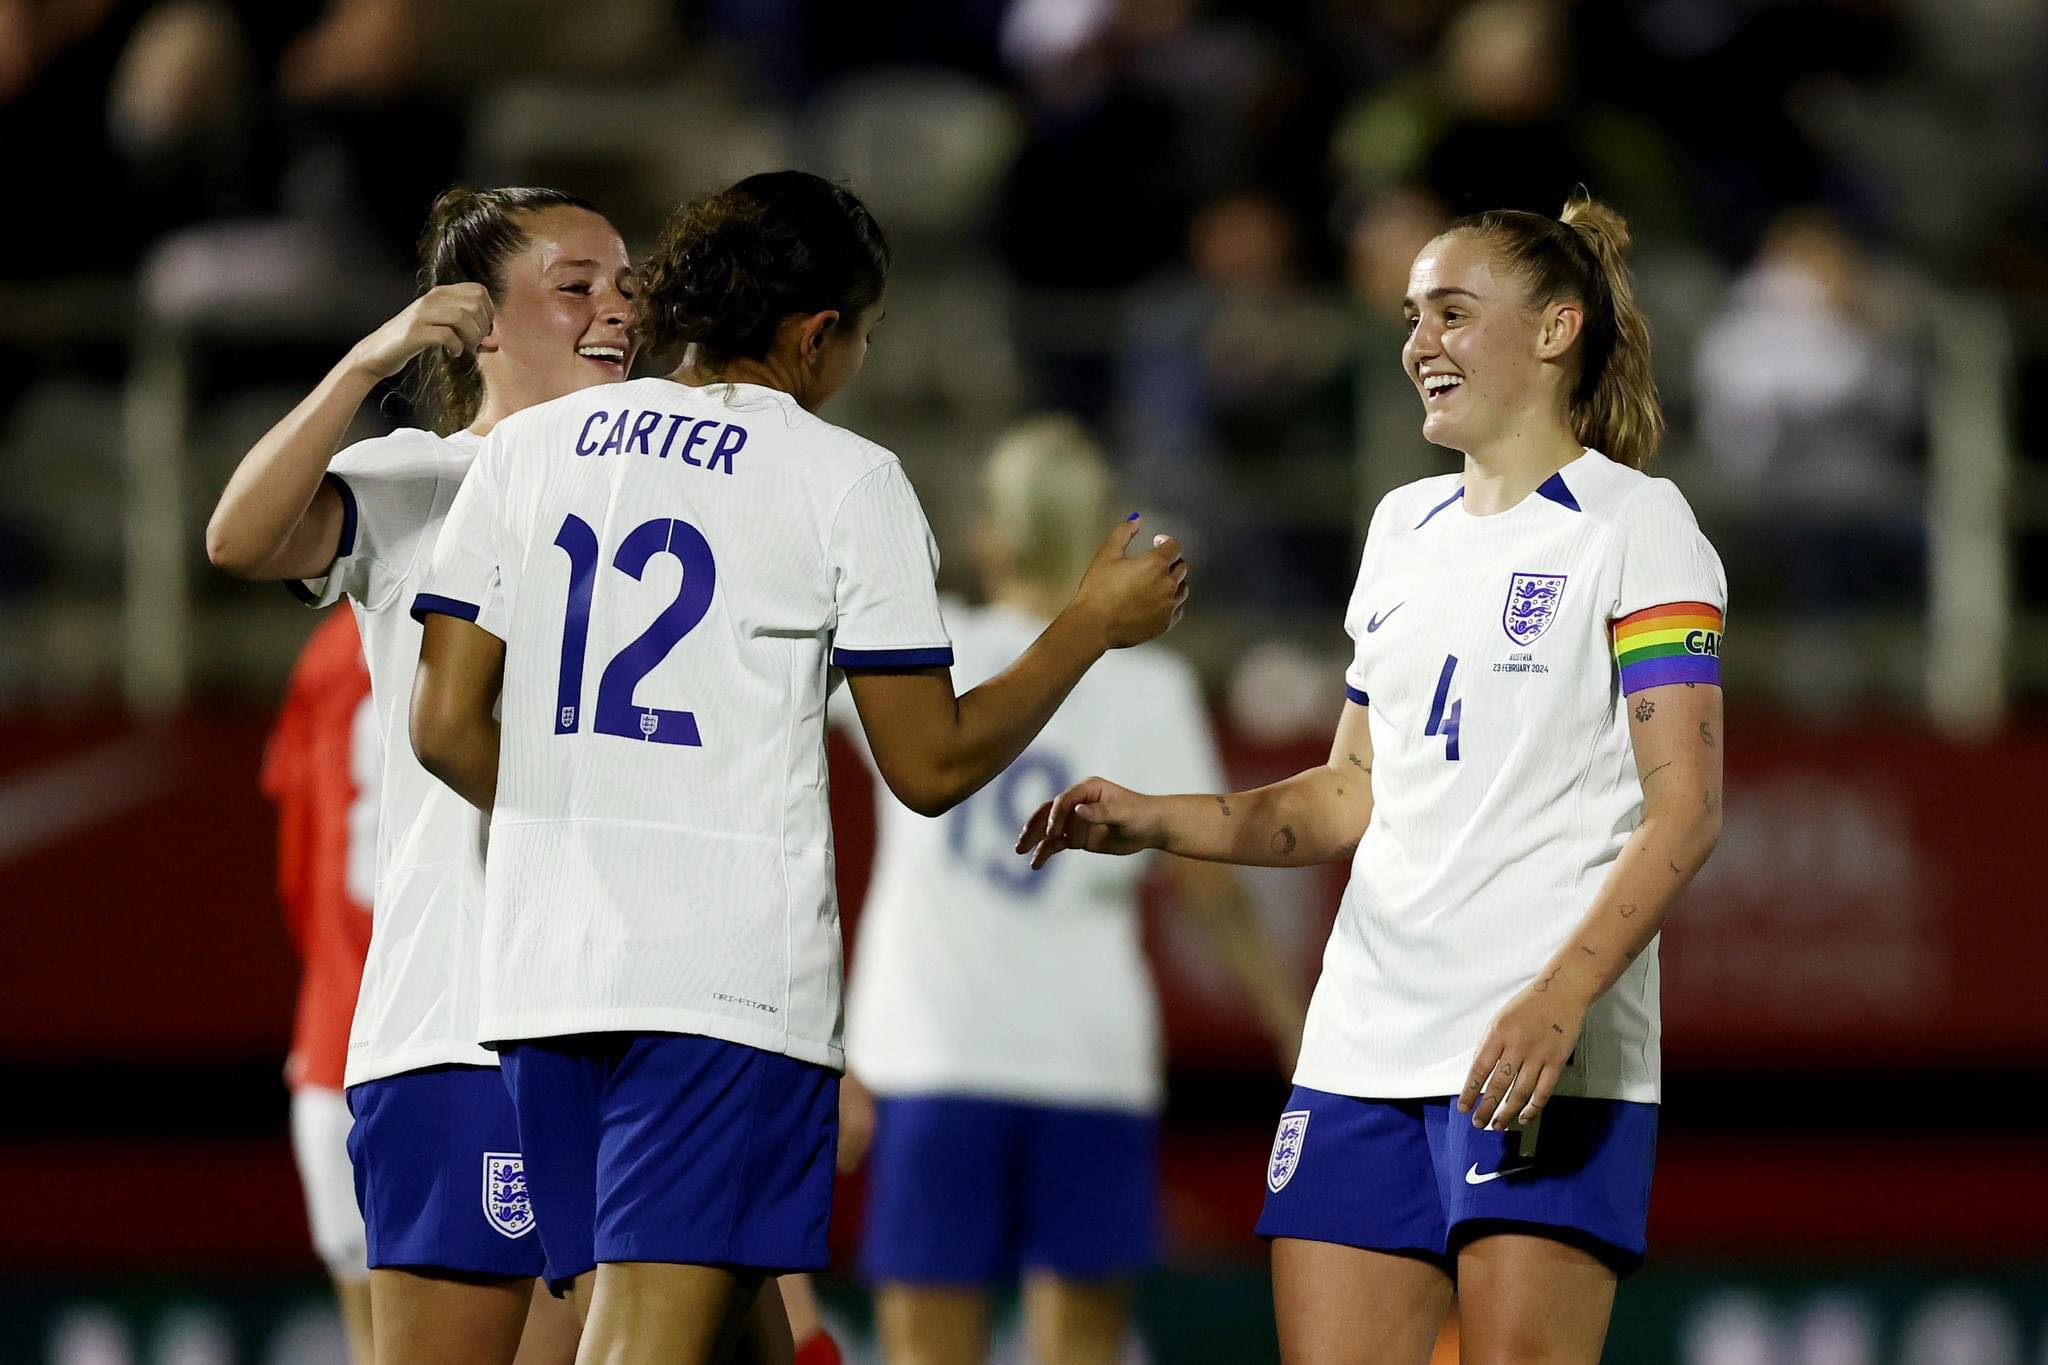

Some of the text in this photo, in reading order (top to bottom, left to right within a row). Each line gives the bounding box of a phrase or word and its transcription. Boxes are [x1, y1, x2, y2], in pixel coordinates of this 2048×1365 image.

[575, 410, 747, 475] CARTER
[553, 513, 716, 747] 12
[1685, 630, 1721, 656] CA
[1492, 663, 1549, 673] 23 FEBRUARY 2024
[1509, 653, 1532, 661] AUSTRIA
[1424, 653, 1462, 761] 4
